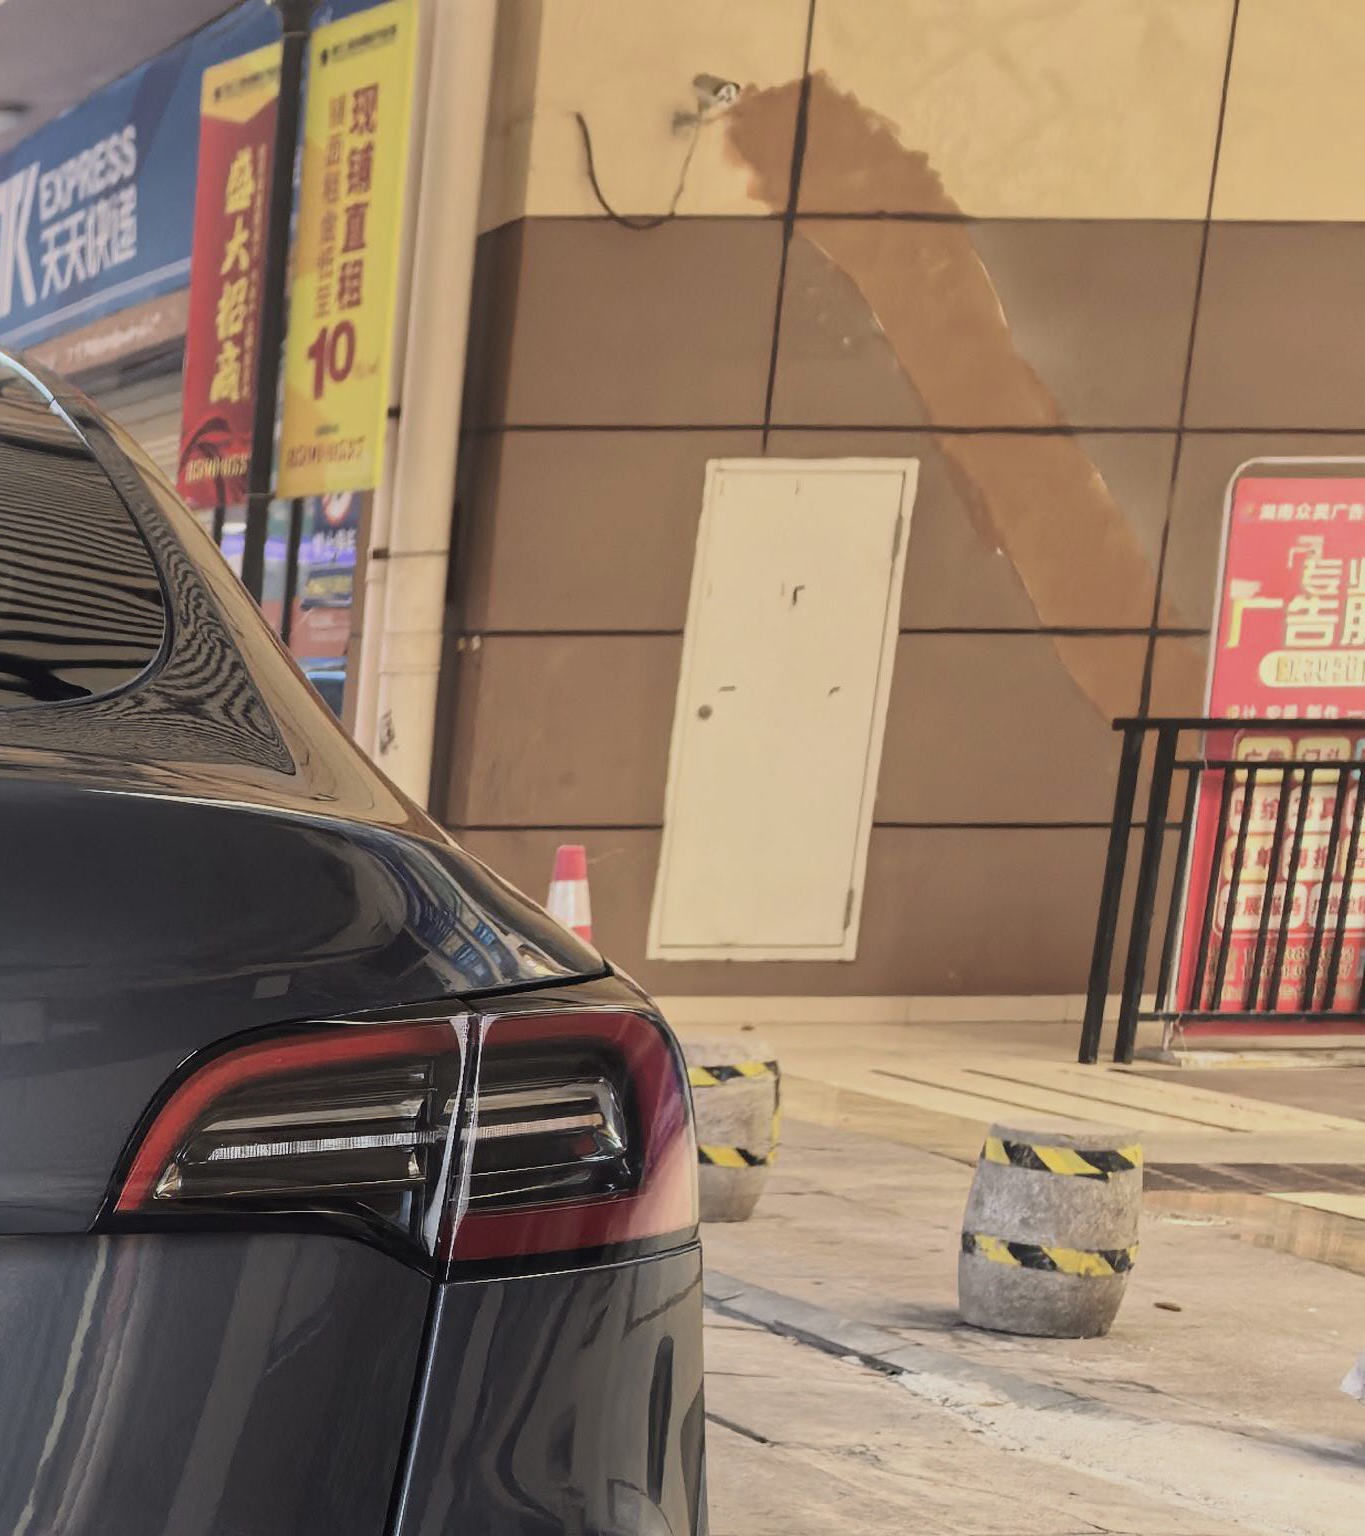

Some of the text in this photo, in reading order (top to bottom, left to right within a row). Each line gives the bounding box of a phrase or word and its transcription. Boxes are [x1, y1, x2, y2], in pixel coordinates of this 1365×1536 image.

[38, 124, 137, 222] EXPRESS
[39, 182, 138, 300] 天天快递
[209, 147, 257, 403] 盛大招商
[307, 320, 357, 401] 10
